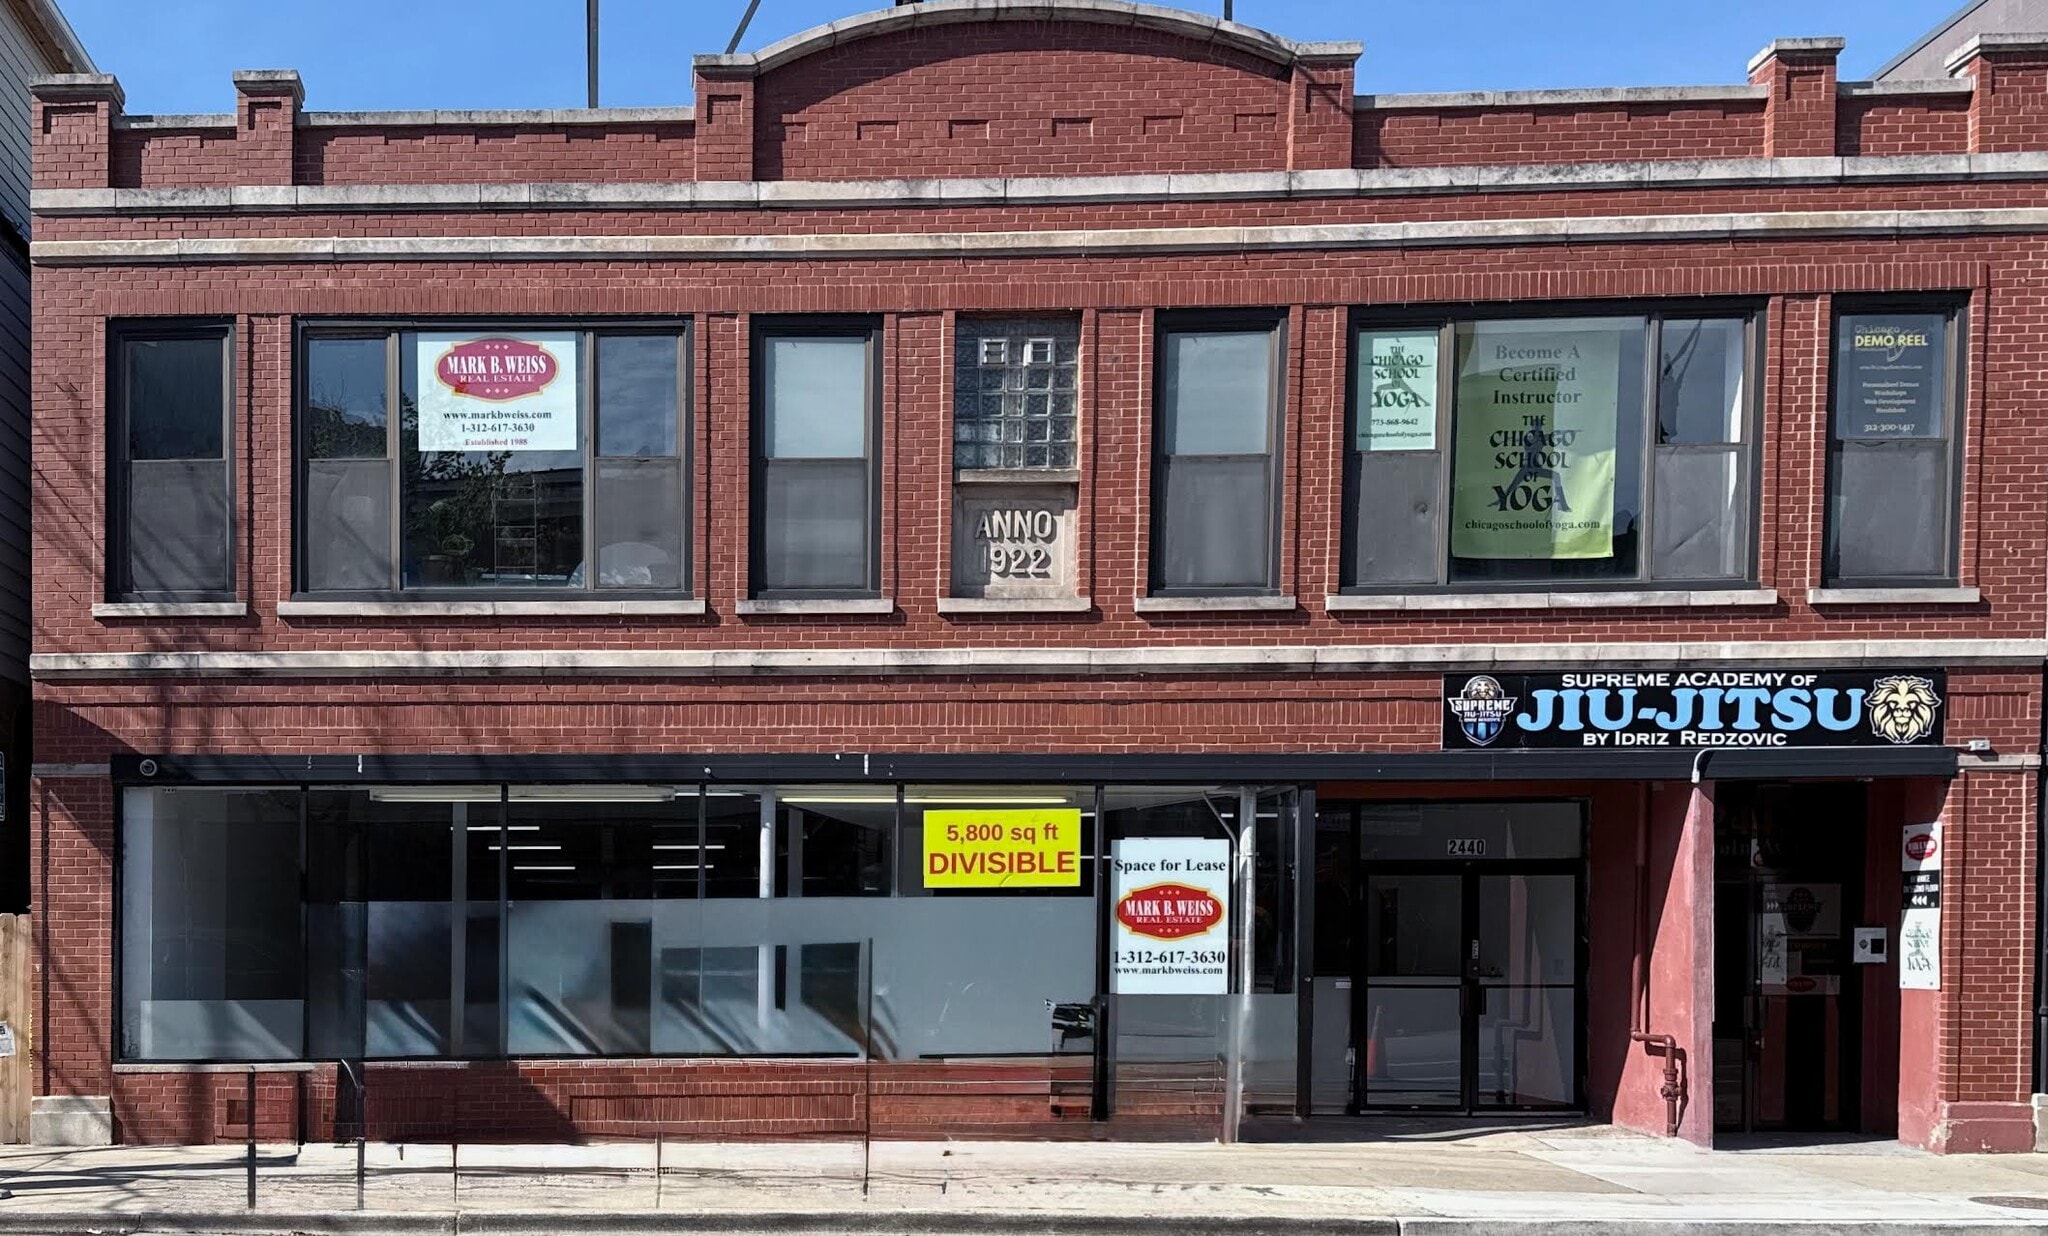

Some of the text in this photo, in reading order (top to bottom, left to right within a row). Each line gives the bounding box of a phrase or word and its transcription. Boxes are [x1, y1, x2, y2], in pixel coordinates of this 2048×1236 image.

[1854, 335, 1928, 347] DEMO REEL
[1495, 344, 1580, 359] Become A
[447, 355, 547, 374] MARK B. WEISS
[1371, 354, 1424, 367] CHICAGO
[460, 374, 535, 383] REAL ESTATE
[1374, 368, 1421, 379] SCHOOL
[1499, 367, 1576, 382] Certified
[1372, 391, 1421, 408] YOGA
[1493, 390, 1582, 404] Instructor
[443, 410, 552, 420] www.markbweiss.com
[1522, 415, 1546, 427] THE
[461, 423, 535, 433] 1-312-617-3630
[465, 438, 508, 446] Established
[1489, 430, 1577, 448] CHICAGO
[1494, 451, 1570, 469] SCHOOL
[1523, 471, 1539, 483] OF
[1490, 485, 1573, 512] YOGA
[976, 509, 1054, 540] ANNO
[1465, 519, 1600, 531] chicagoschoolofyoga.com
[979, 548, 1050, 576] 1922
[1561, 672, 1818, 688] SUPREME ACADEMY OF
[1454, 699, 1511, 711] SUPREME
[1516, 687, 1867, 732] JIU-JITSU
[1583, 730, 1788, 746] BY IDRIZ REDZOVIC
[946, 823, 1059, 844] 5,800 sq ft
[1449, 840, 1485, 855] 2440
[928, 851, 1076, 875] DIVISIBLE
[1114, 859, 1226, 875] Space for Lease
[1125, 899, 1214, 916] MARK B. WEISS
[1136, 916, 1203, 924] REAL ESTATE
[1114, 950, 1226, 964] 1-312-617-3630
[1114, 965, 1223, 975] www.markbweiss.com
